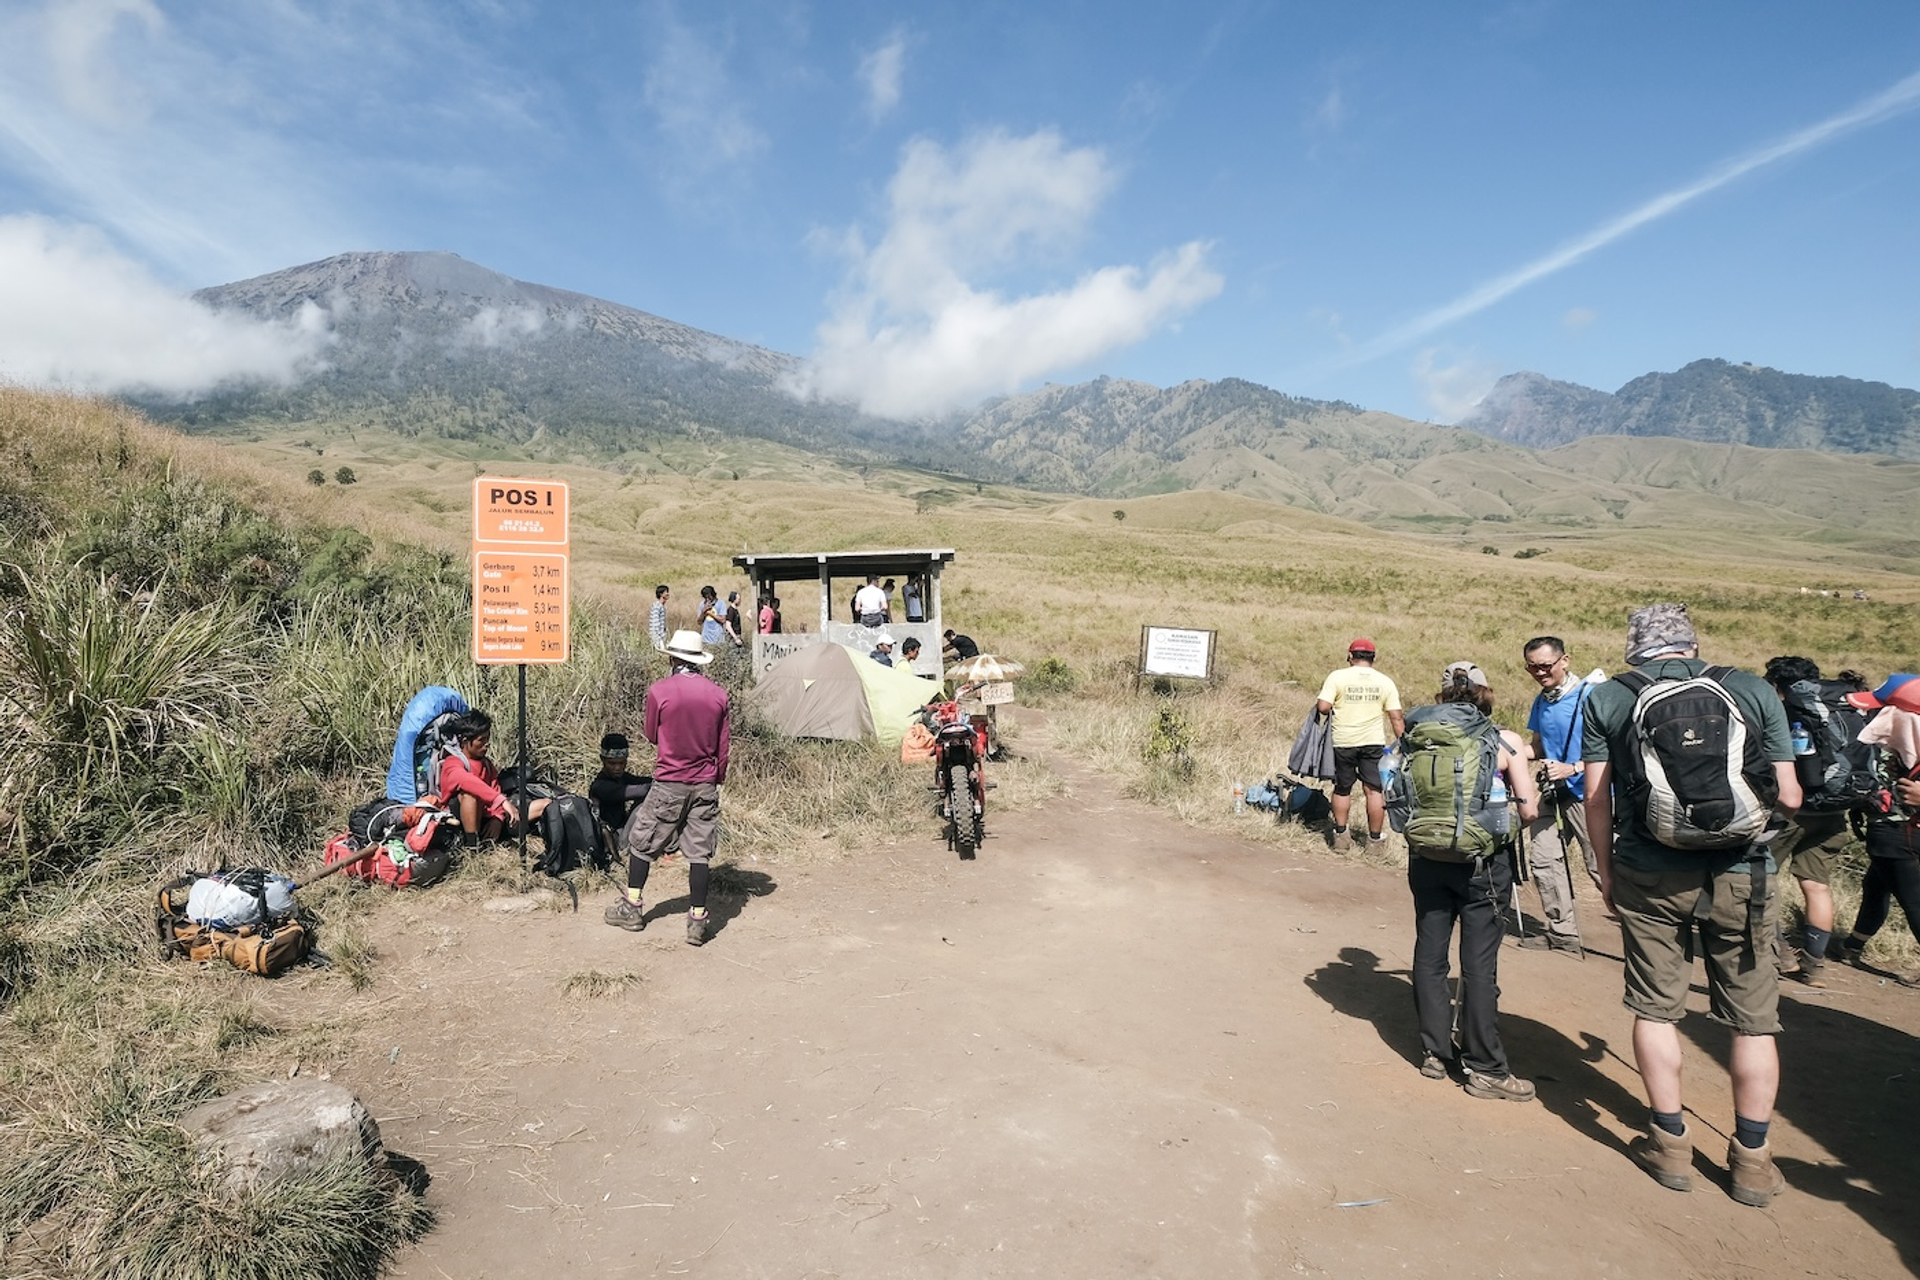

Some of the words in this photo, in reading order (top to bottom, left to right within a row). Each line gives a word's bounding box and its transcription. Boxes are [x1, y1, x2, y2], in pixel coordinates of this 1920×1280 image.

[491, 488, 538, 506] POS
[546, 491, 552, 506] I
[482, 562, 515, 571] Gerbang
[532, 565, 545, 578] 3,7
[547, 566, 559, 577] km
[482, 584, 500, 593] Pos
[503, 585, 510, 593] II
[533, 584, 545, 597] 1,4
[547, 585, 559, 595] km
[534, 602, 546, 615] 5,3
[547, 603, 559, 614] km
[483, 625, 496, 633] Top
[534, 621, 546, 633] 9,1
[548, 622, 560, 632] km
[540, 641, 546, 651] 9
[547, 641, 560, 651] km
